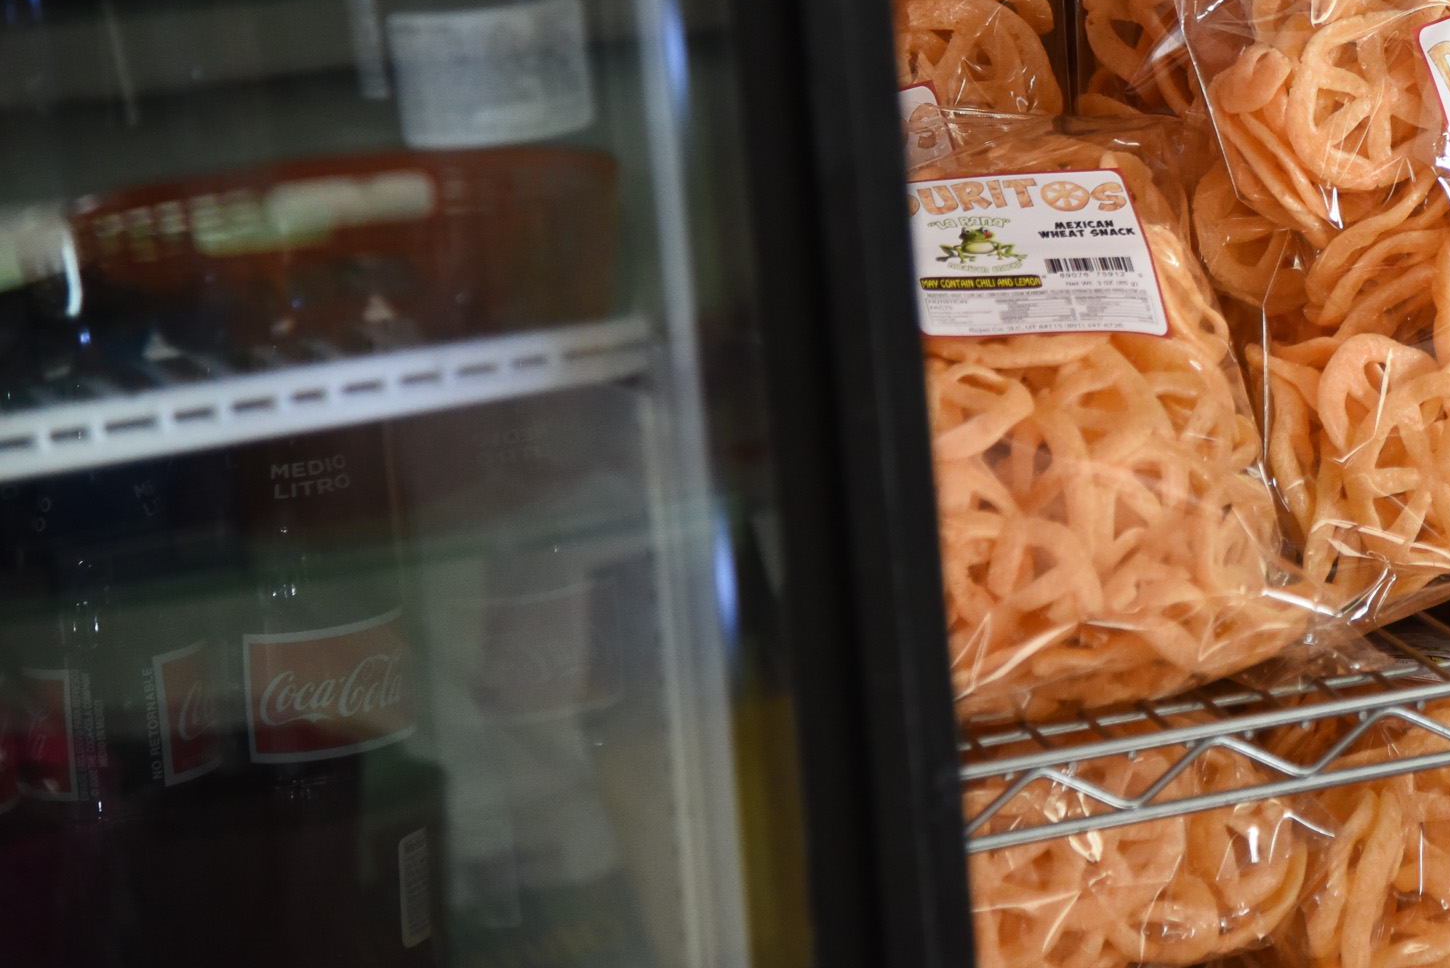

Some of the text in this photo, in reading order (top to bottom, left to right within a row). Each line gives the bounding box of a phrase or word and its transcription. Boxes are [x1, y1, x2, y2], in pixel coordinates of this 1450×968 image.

[1038, 227, 1136, 240] WHEAT SNACK
[1054, 220, 1114, 230] MEXICAN
[921, 277, 1041, 289] MAY CONTAIN CHILI AND LEMON
[270, 454, 347, 480] MEDIO
[273, 473, 351, 500] LITRO
[142, 667, 164, 781] NO RETORNABLE
